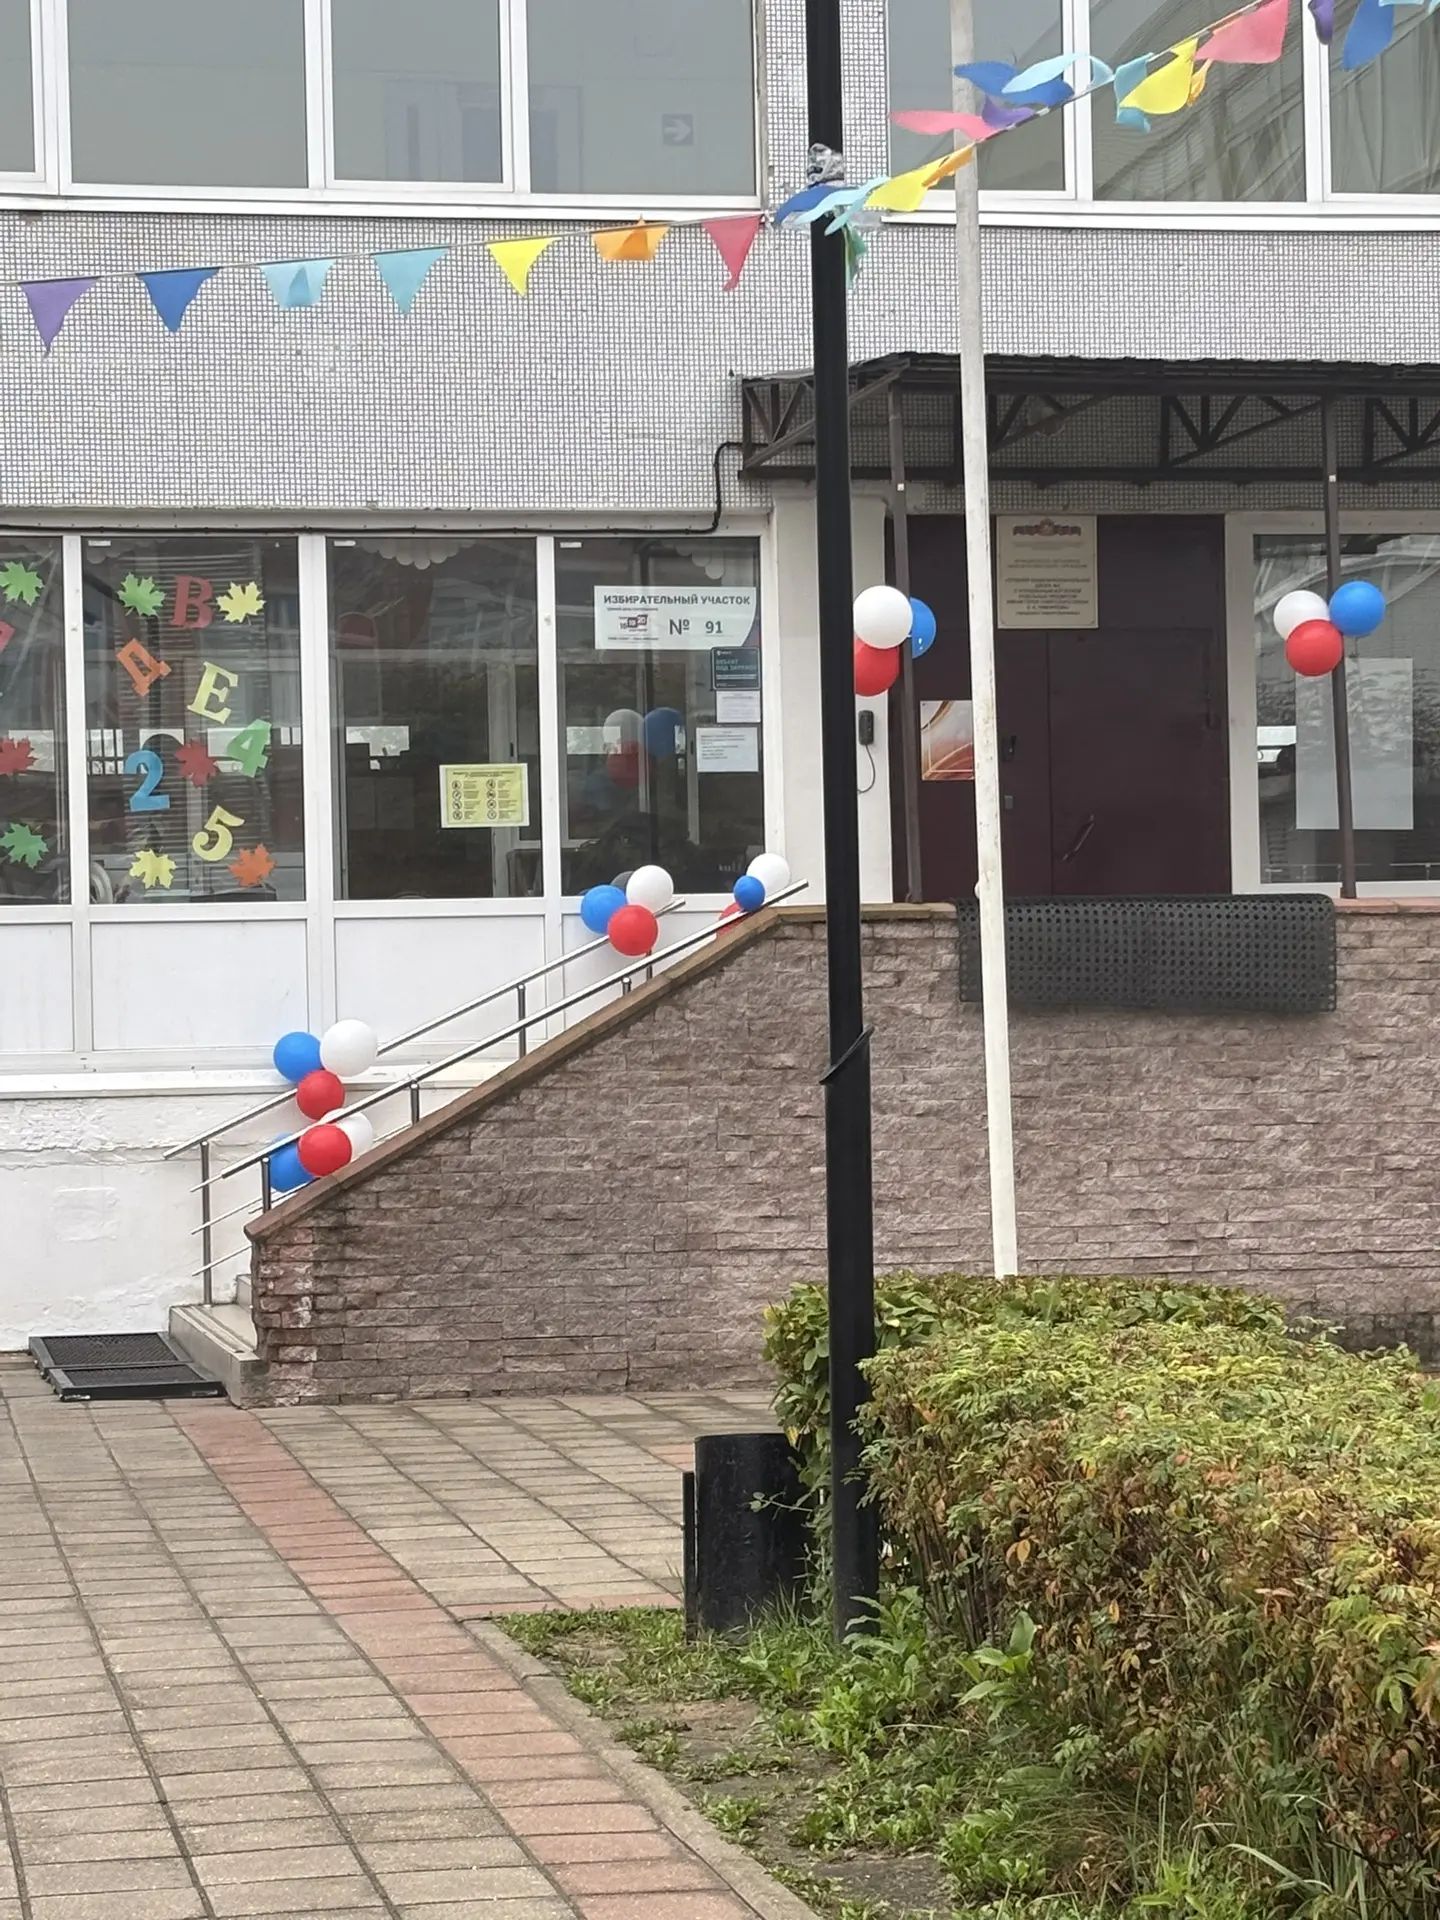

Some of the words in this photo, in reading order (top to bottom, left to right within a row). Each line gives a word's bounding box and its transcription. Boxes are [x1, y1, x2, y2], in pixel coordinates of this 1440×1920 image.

[169, 575, 214, 629] В
[603, 593, 698, 606] ИЗБИРАТЕЛЬНЫЙ
[701, 595, 751, 606] УЧАСТОК
[668, 618, 691, 636] №
[705, 620, 724, 634] 91
[115, 638, 171, 697] Д
[187, 661, 239, 724] Е
[124, 750, 171, 812] 2
[192, 805, 245, 861] 5
